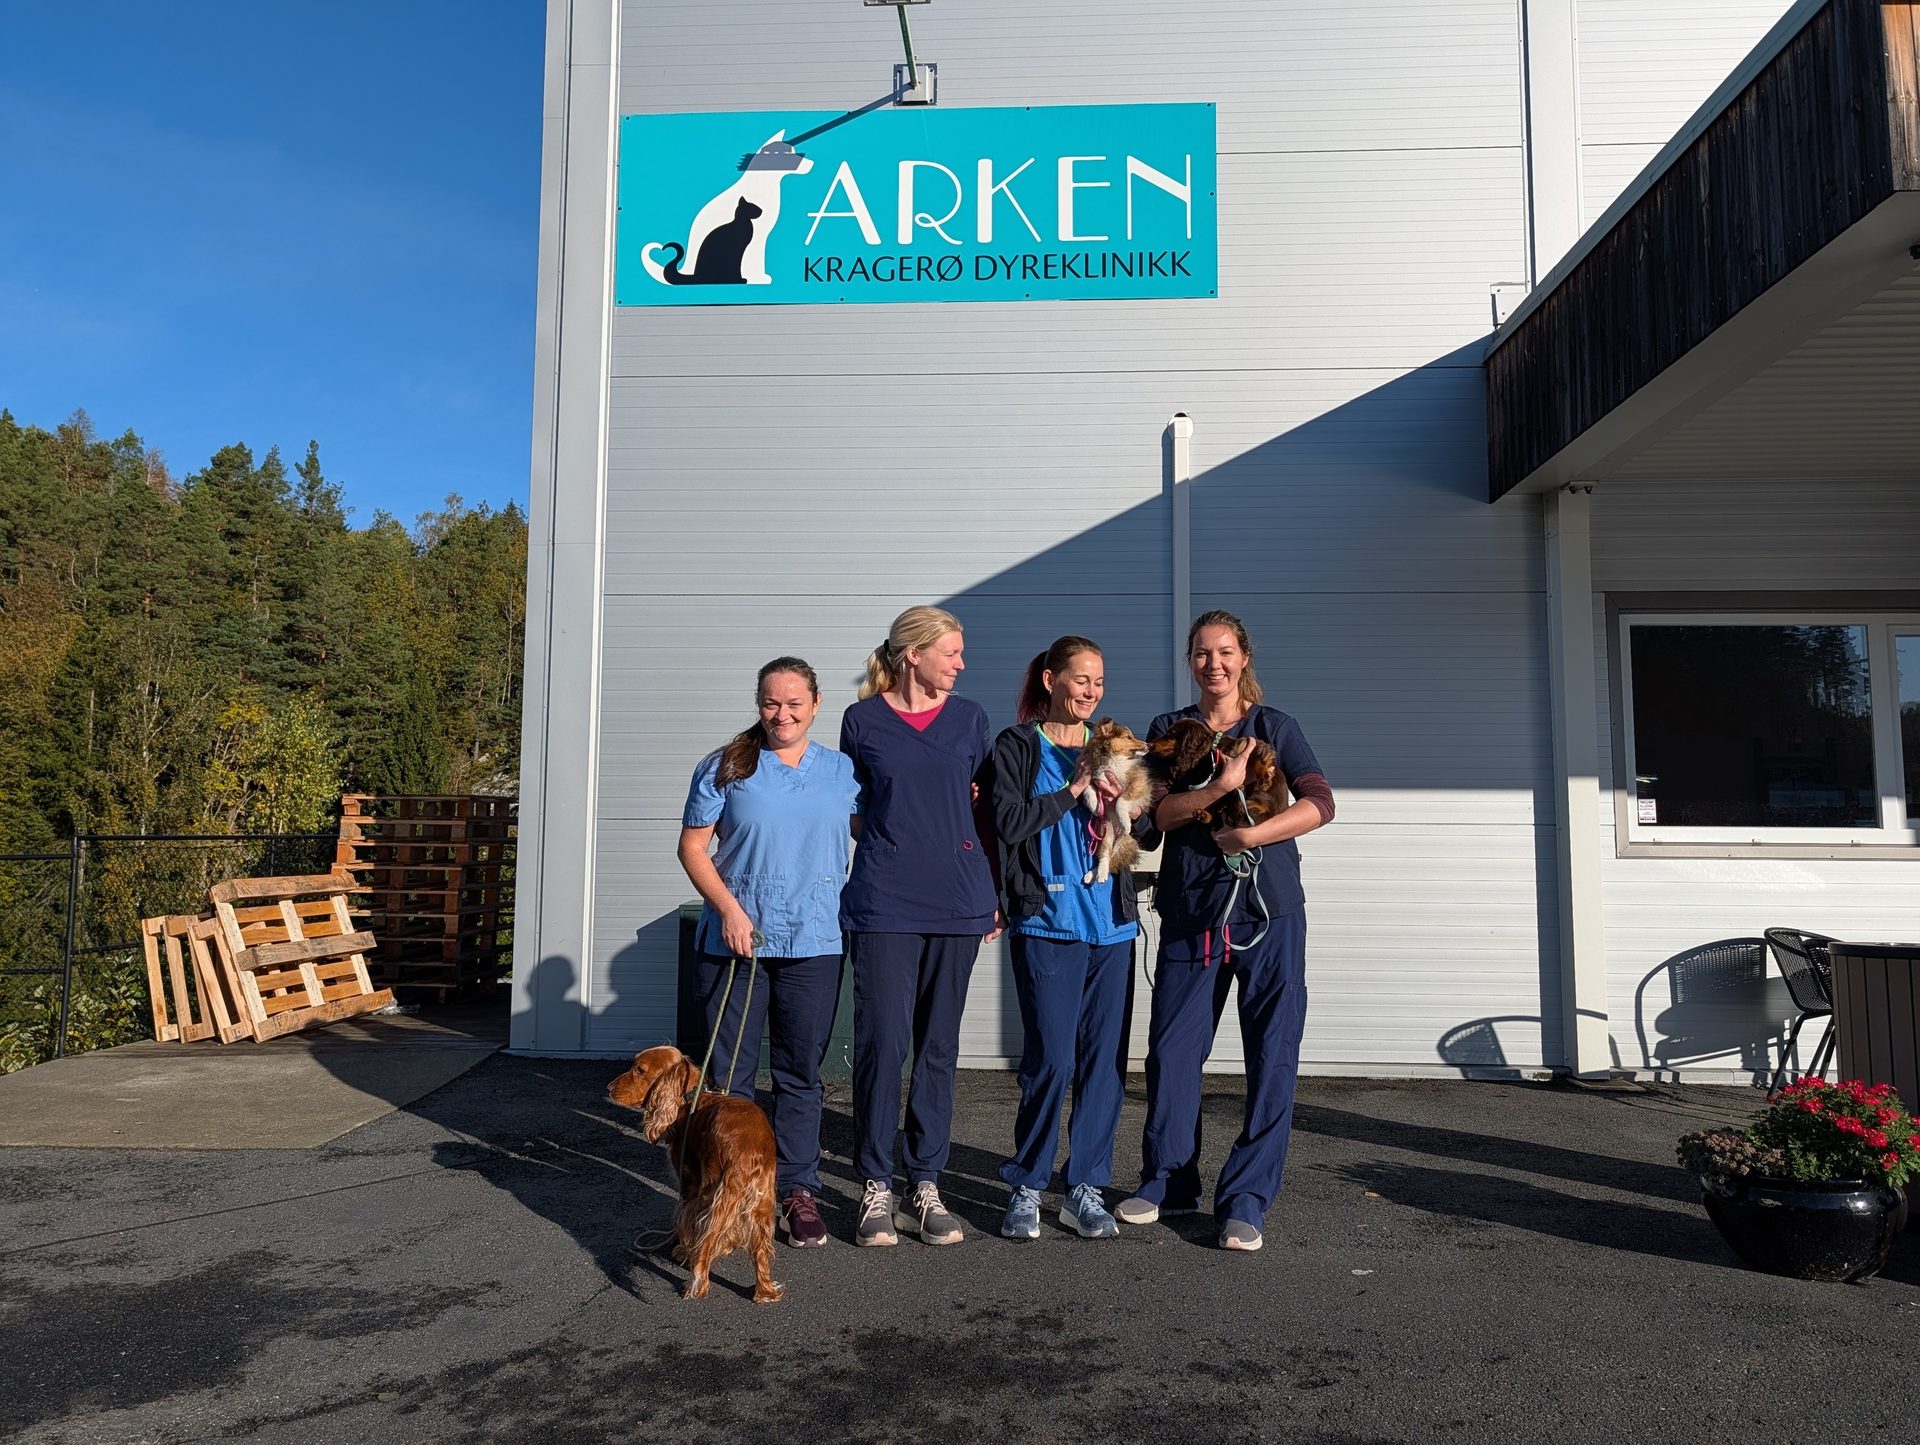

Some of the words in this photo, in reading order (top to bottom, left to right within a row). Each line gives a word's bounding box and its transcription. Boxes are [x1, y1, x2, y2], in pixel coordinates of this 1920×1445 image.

[804, 154, 1192, 246] ARKEN
[803, 253, 964, 283] KRAGERØ
[974, 250, 1193, 282] DYREKLINIKK
